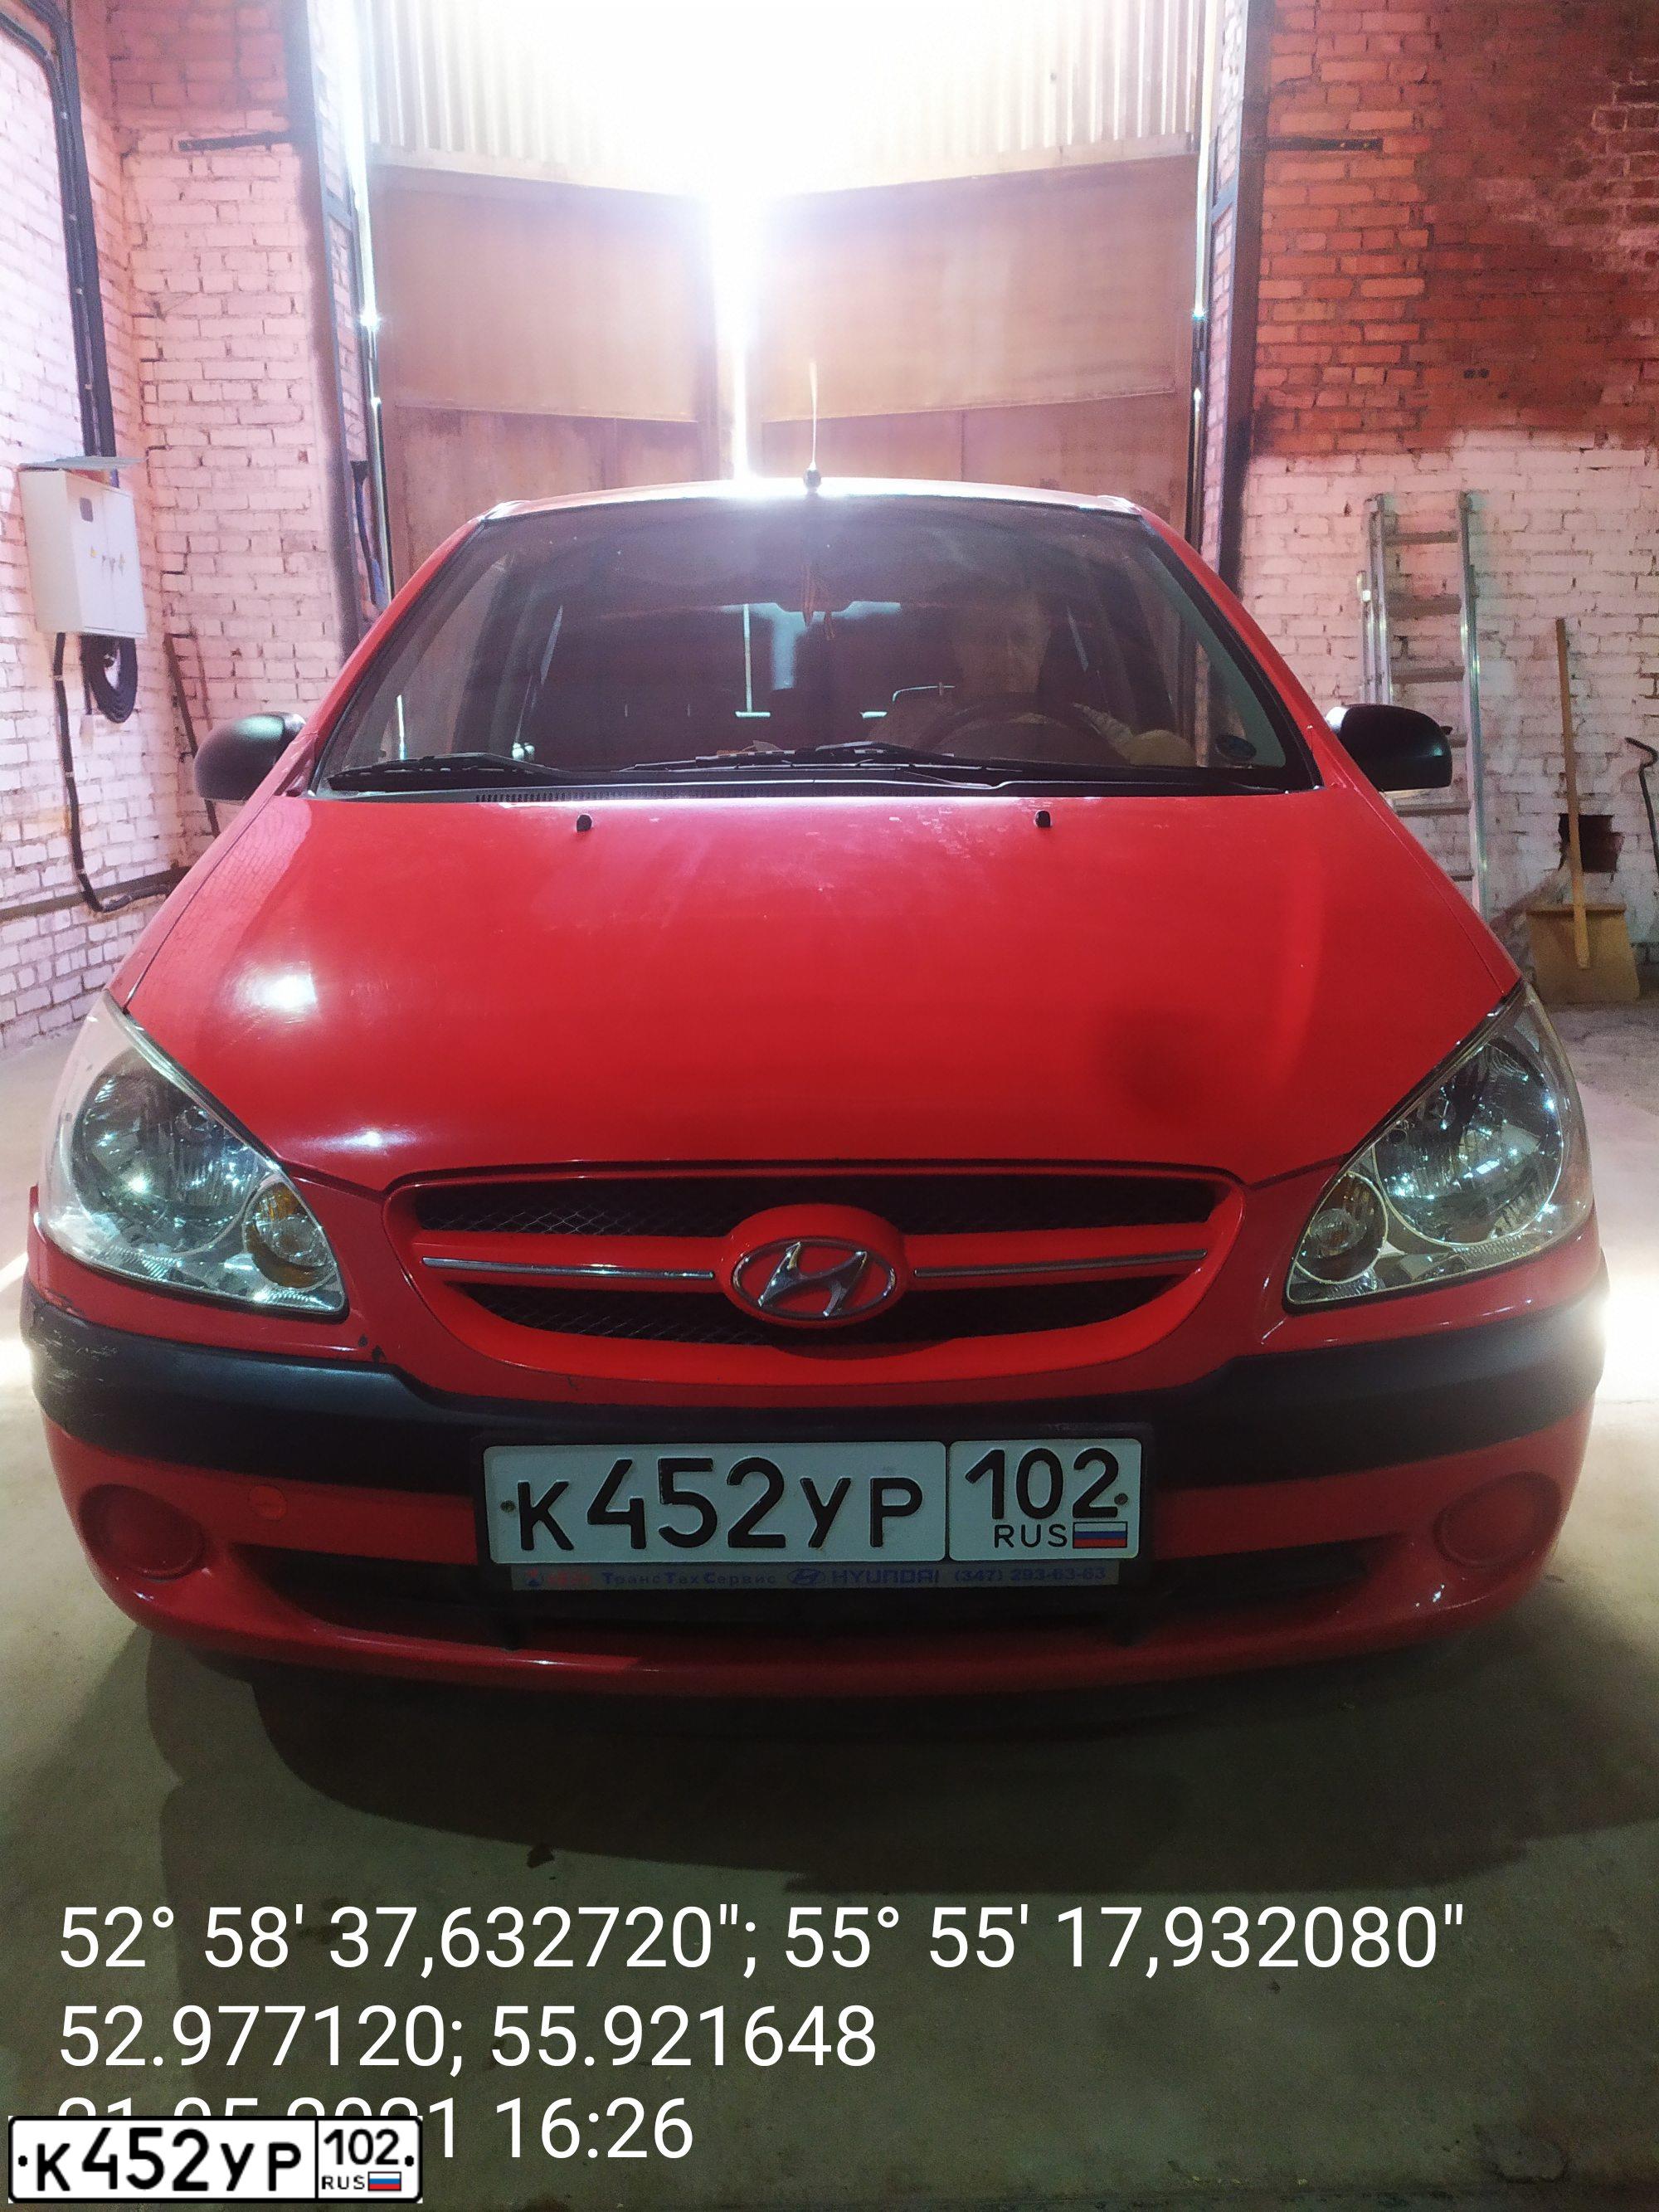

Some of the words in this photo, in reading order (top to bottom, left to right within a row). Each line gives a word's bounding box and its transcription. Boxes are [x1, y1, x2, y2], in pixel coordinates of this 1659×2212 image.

[518, 1457, 922, 1552] К452УР
[965, 1448, 1120, 1521] 102
[995, 1523, 1068, 1549] RUS
[832, 1570, 939, 1585] HYUNDAI
